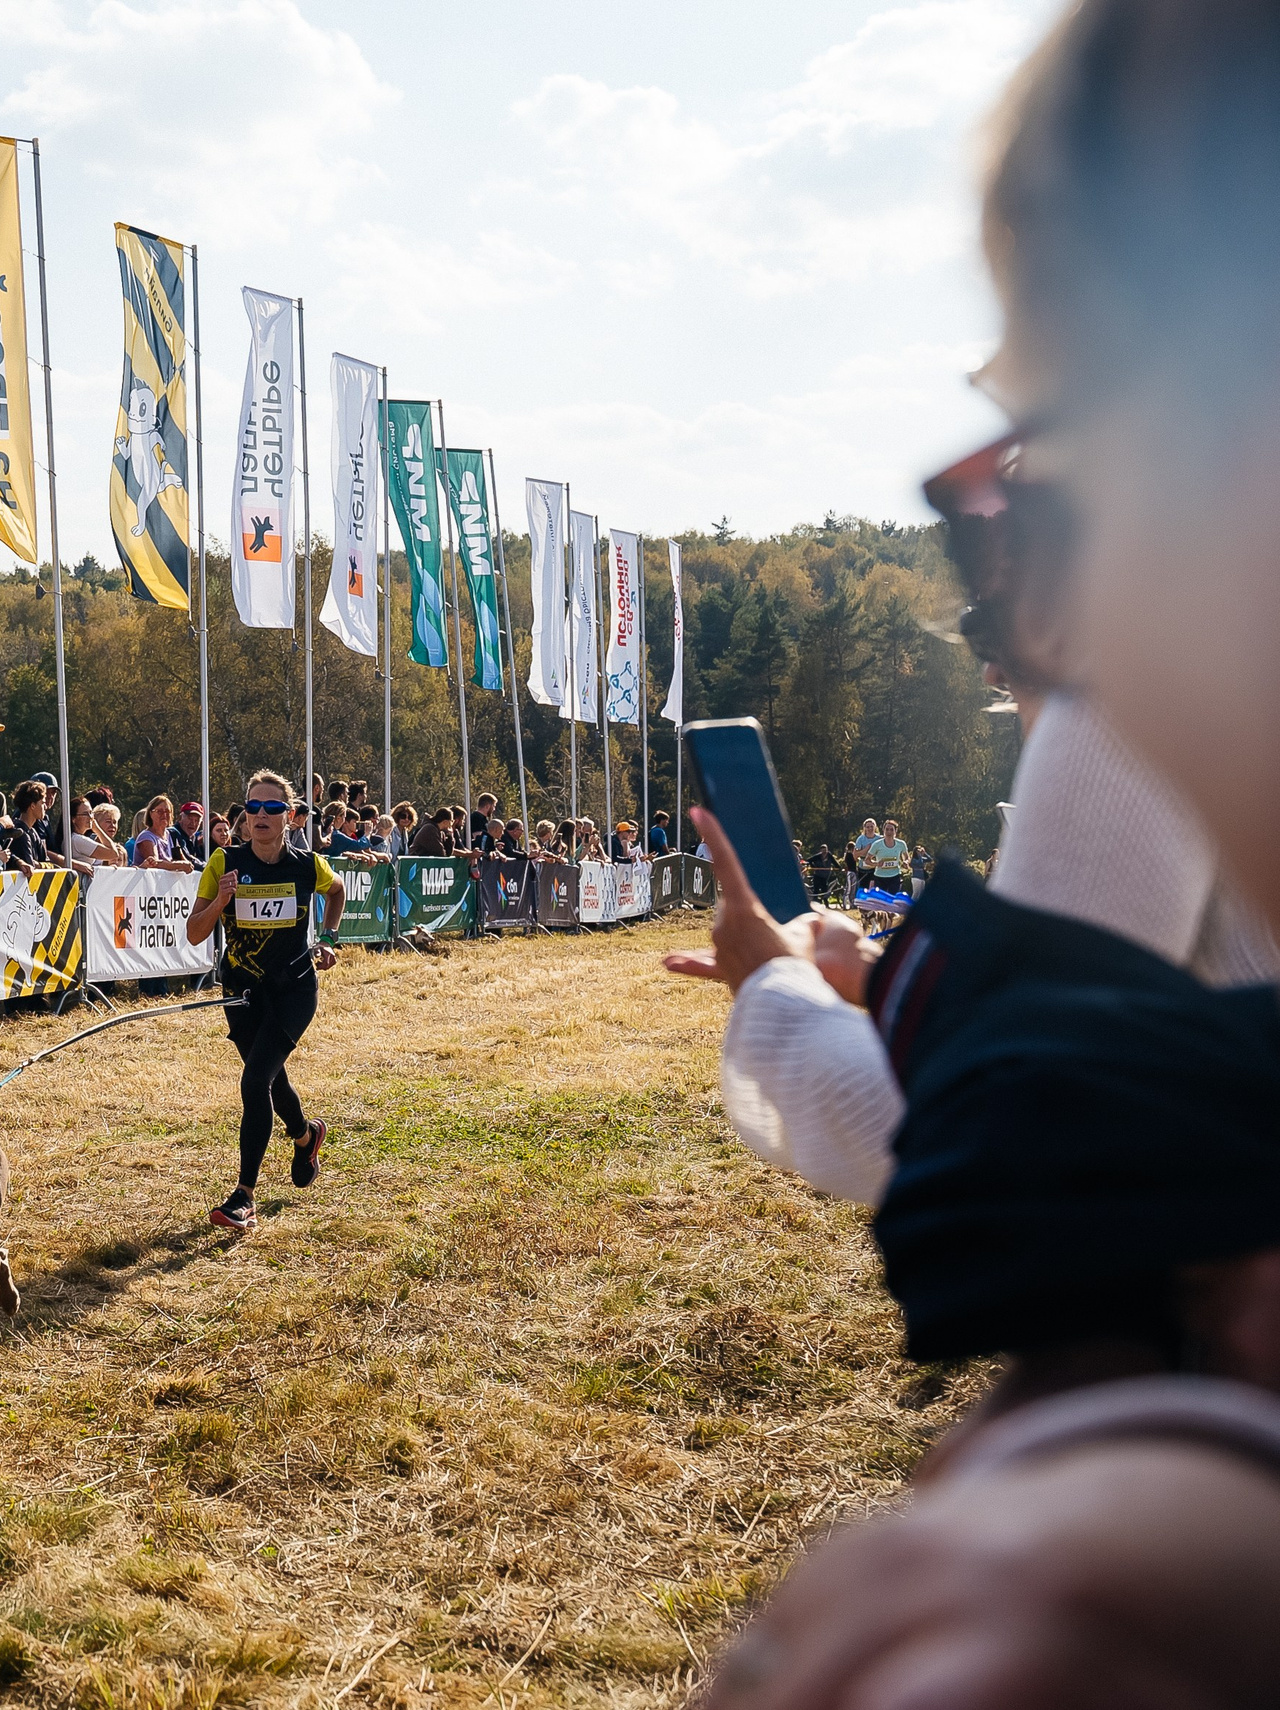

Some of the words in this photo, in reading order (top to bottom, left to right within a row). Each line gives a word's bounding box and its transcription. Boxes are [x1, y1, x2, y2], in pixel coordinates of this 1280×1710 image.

[422, 867, 455, 896] МИР
[138, 895, 189, 922] четыре
[249, 900, 284, 919] 147
[49, 916, 68, 960] билайн
[138, 924, 178, 949] лапы
